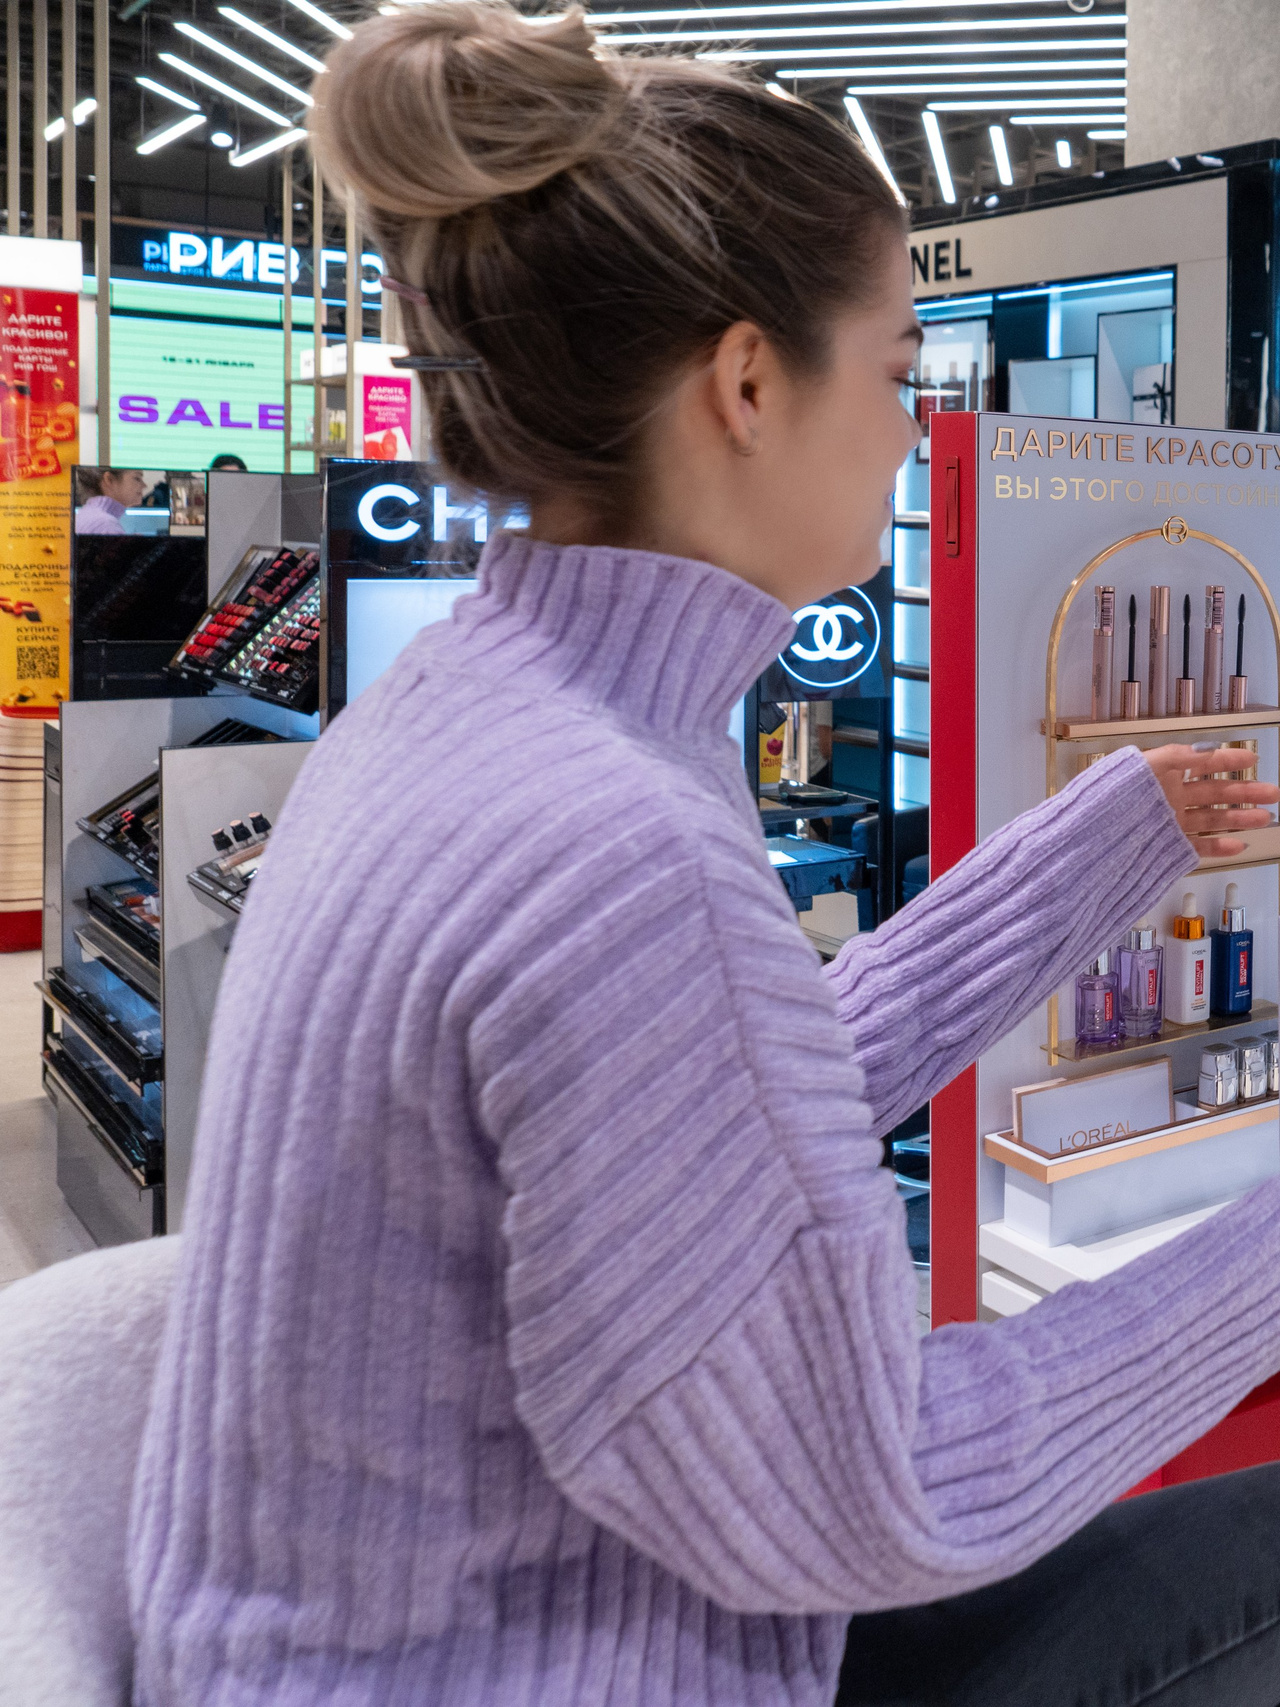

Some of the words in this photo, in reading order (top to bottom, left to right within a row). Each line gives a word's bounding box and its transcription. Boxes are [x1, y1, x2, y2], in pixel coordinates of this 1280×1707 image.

[168, 232, 300, 285] РИВ
[910, 238, 972, 286] NEL
[2, 327, 68, 341] КРАСИВО!
[8, 313, 62, 327] ДАРИТЕ
[118, 394, 284, 430] SALE
[992, 427, 1135, 463] ДАРИТЕ
[995, 475, 1039, 500] ВЫ
[1049, 477, 1144, 502] ЭТОГО
[1060, 1120, 1137, 1151] L'ORÉAL
